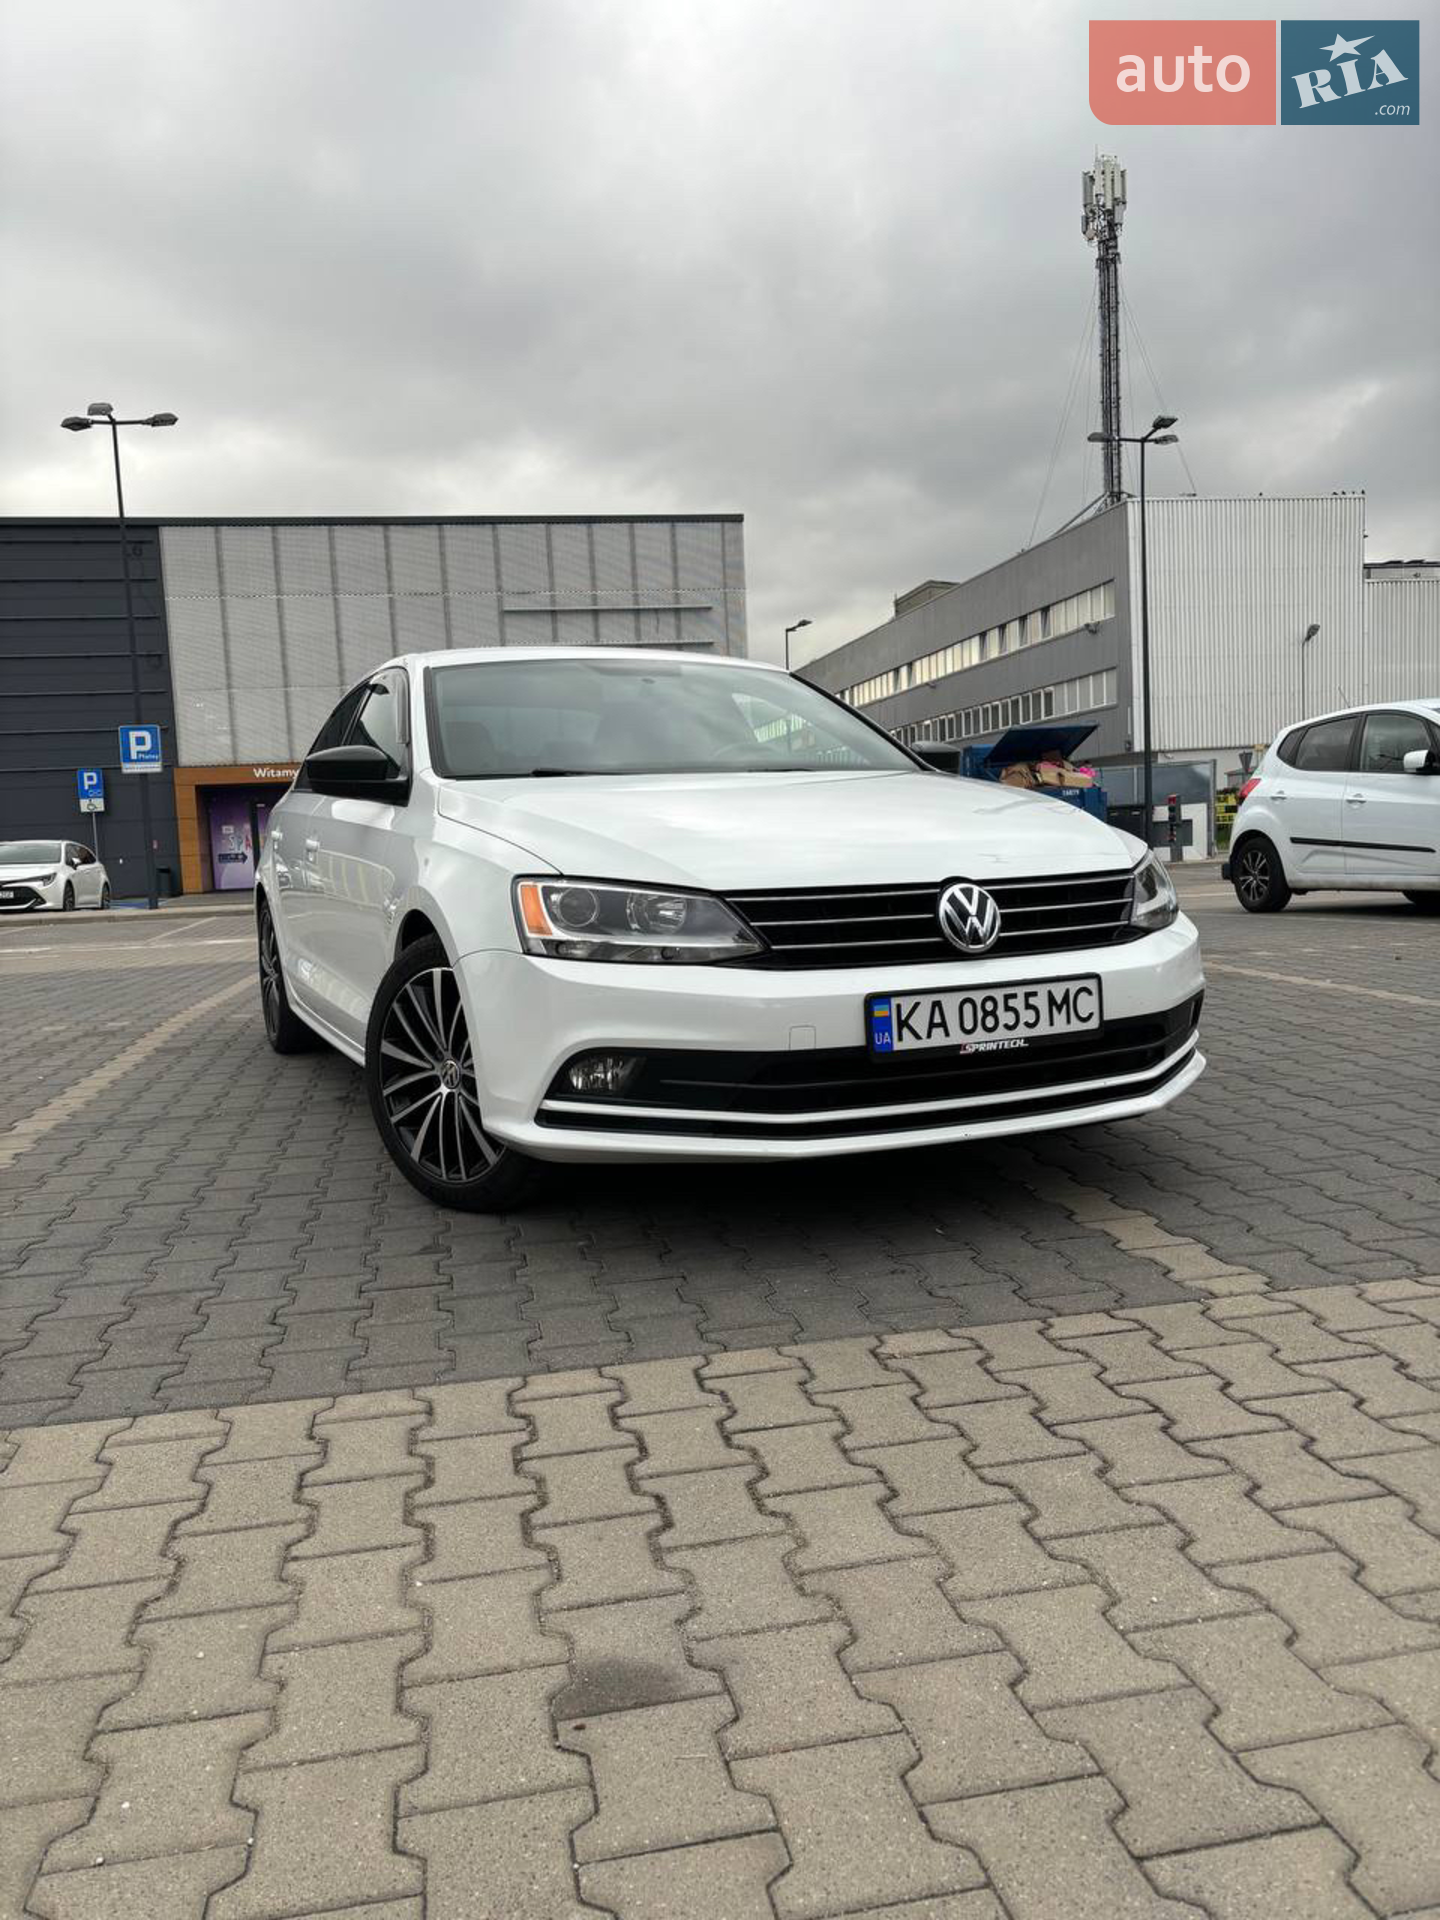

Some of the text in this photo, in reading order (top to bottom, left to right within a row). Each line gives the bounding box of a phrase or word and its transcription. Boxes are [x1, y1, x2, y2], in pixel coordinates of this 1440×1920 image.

[129, 731, 151, 759] P
[84, 772, 97, 789] P
[252, 767, 300, 781] Witamy
[957, 990, 1041, 1036] 0855
[874, 1032, 892, 1045] UA
